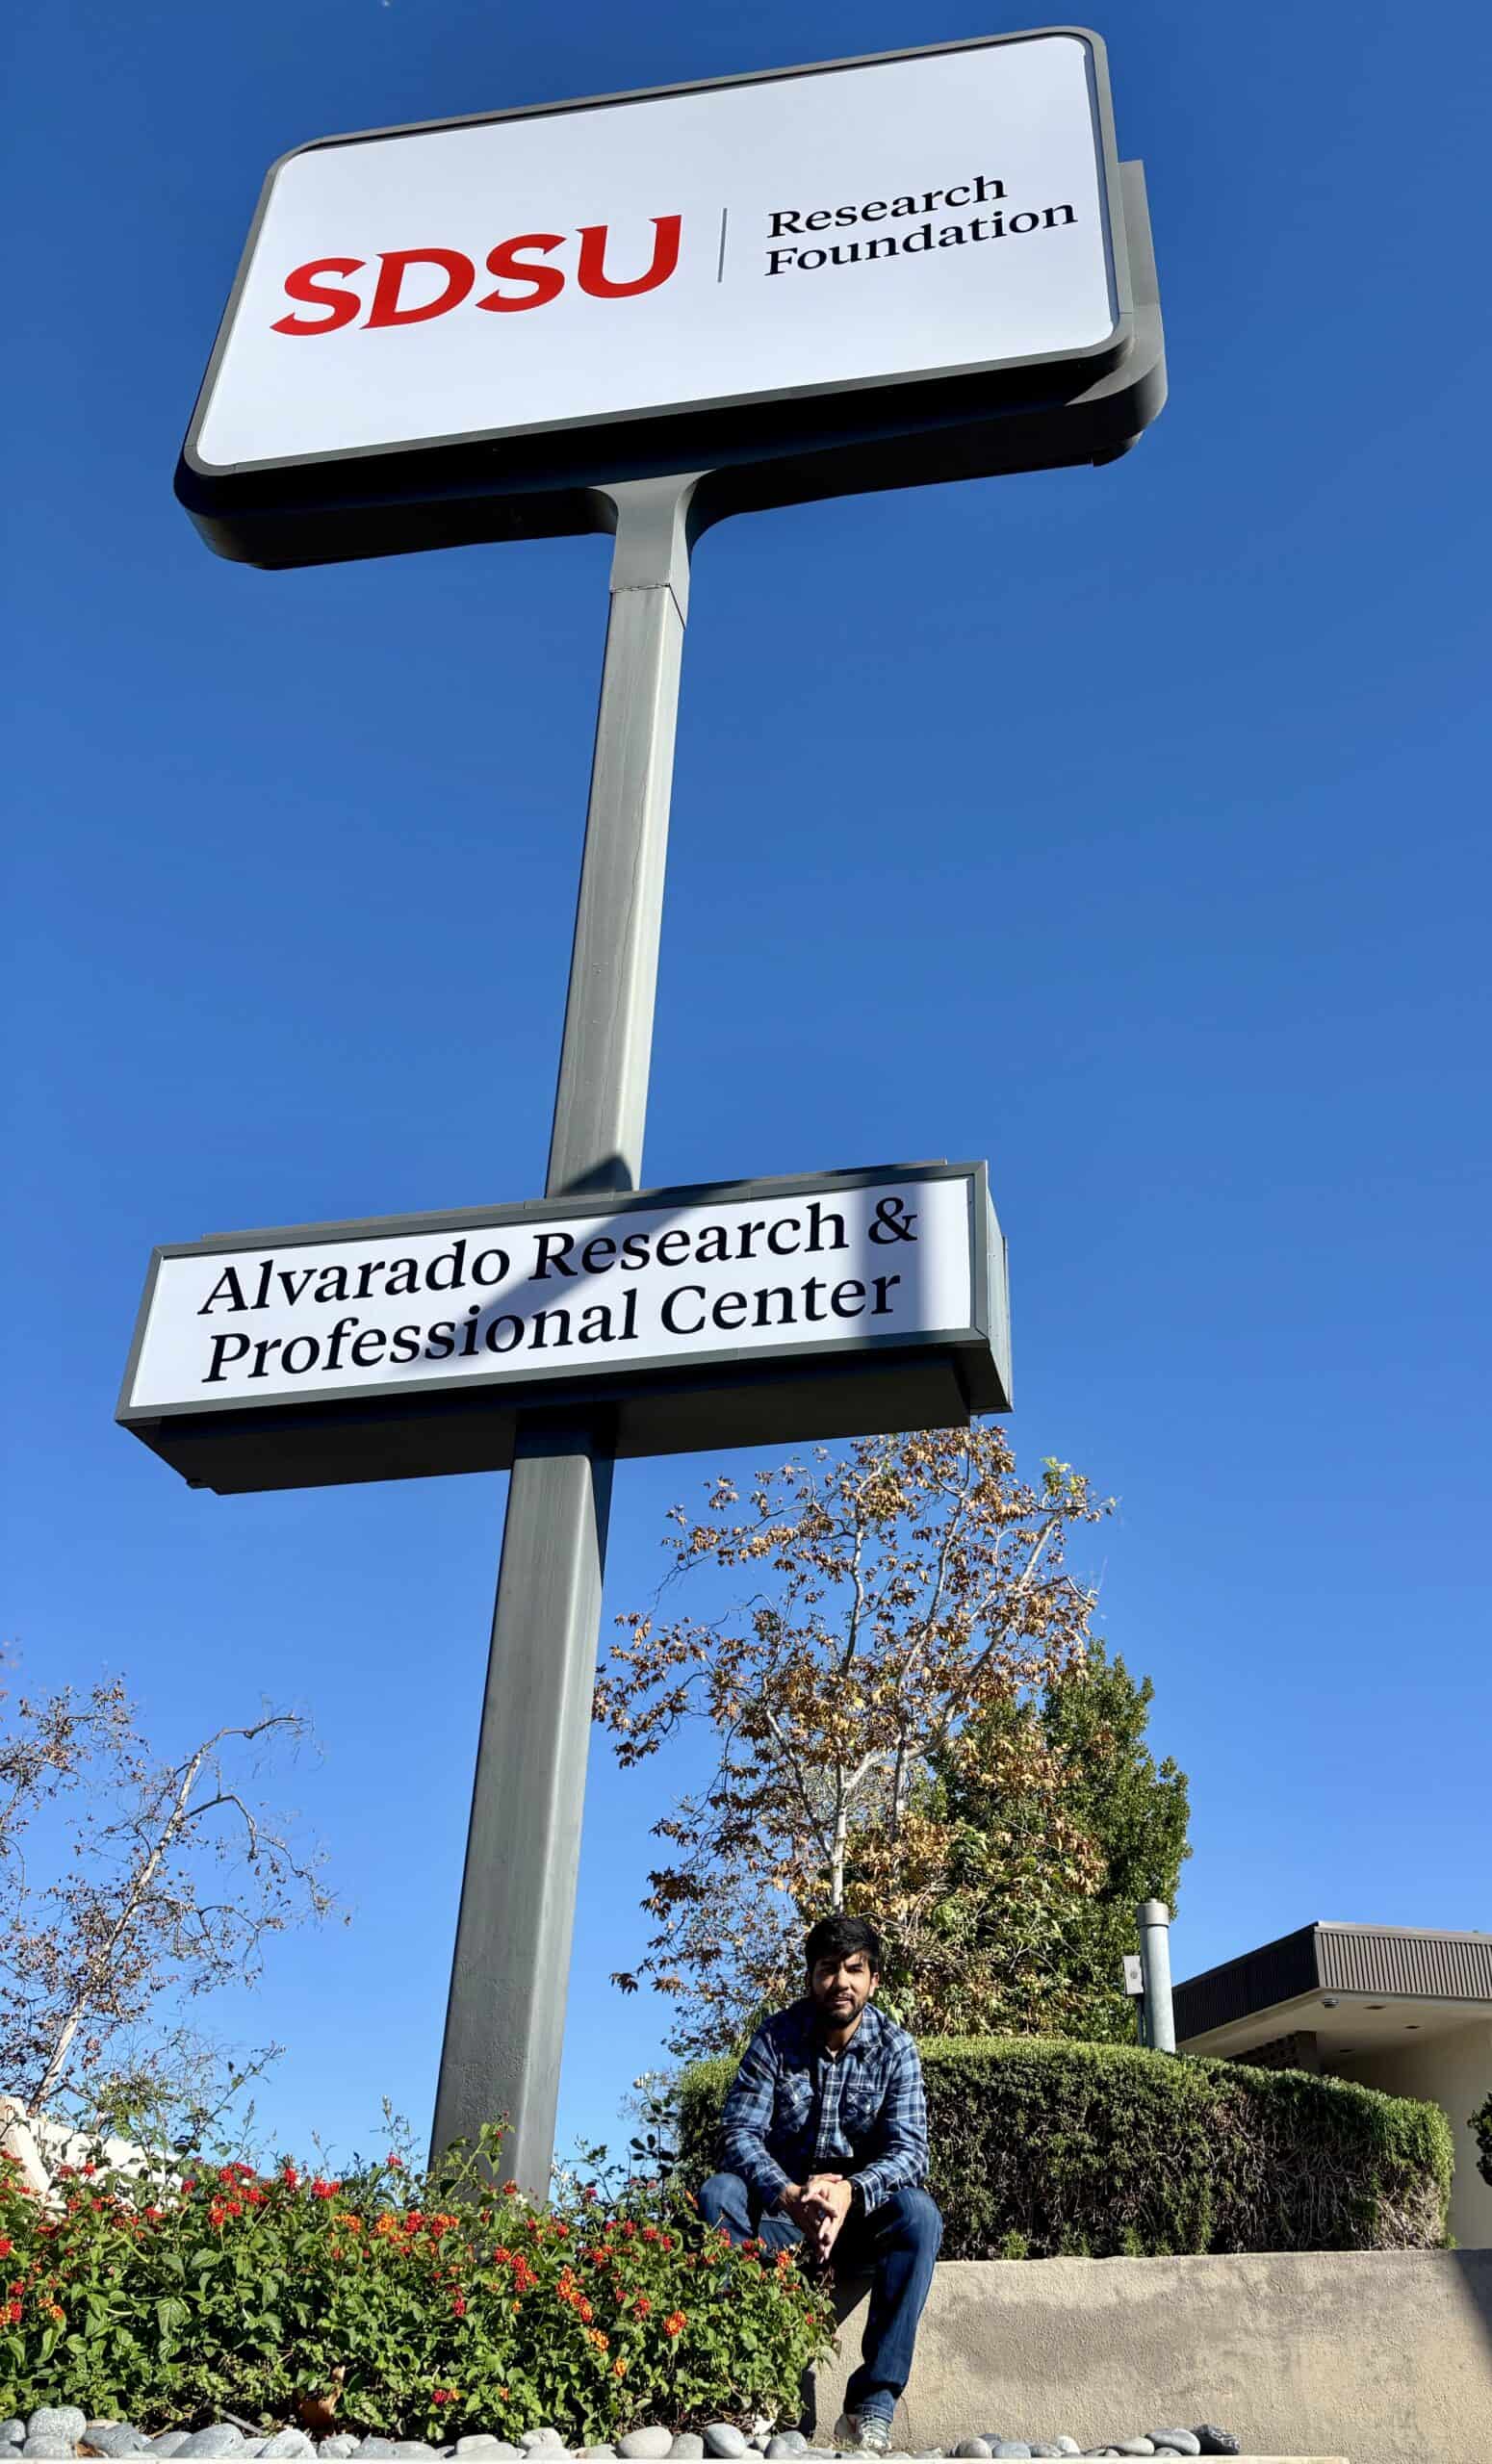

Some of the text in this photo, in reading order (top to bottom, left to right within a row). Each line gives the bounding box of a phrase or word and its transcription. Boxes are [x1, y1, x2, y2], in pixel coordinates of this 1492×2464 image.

[764, 199, 1079, 277] Foundation
[766, 175, 1008, 240] Research
[270, 214, 682, 336] SDSU
[196, 1195, 918, 1315] Alvarado Research &
[201, 1273, 902, 1383] Professional Center
